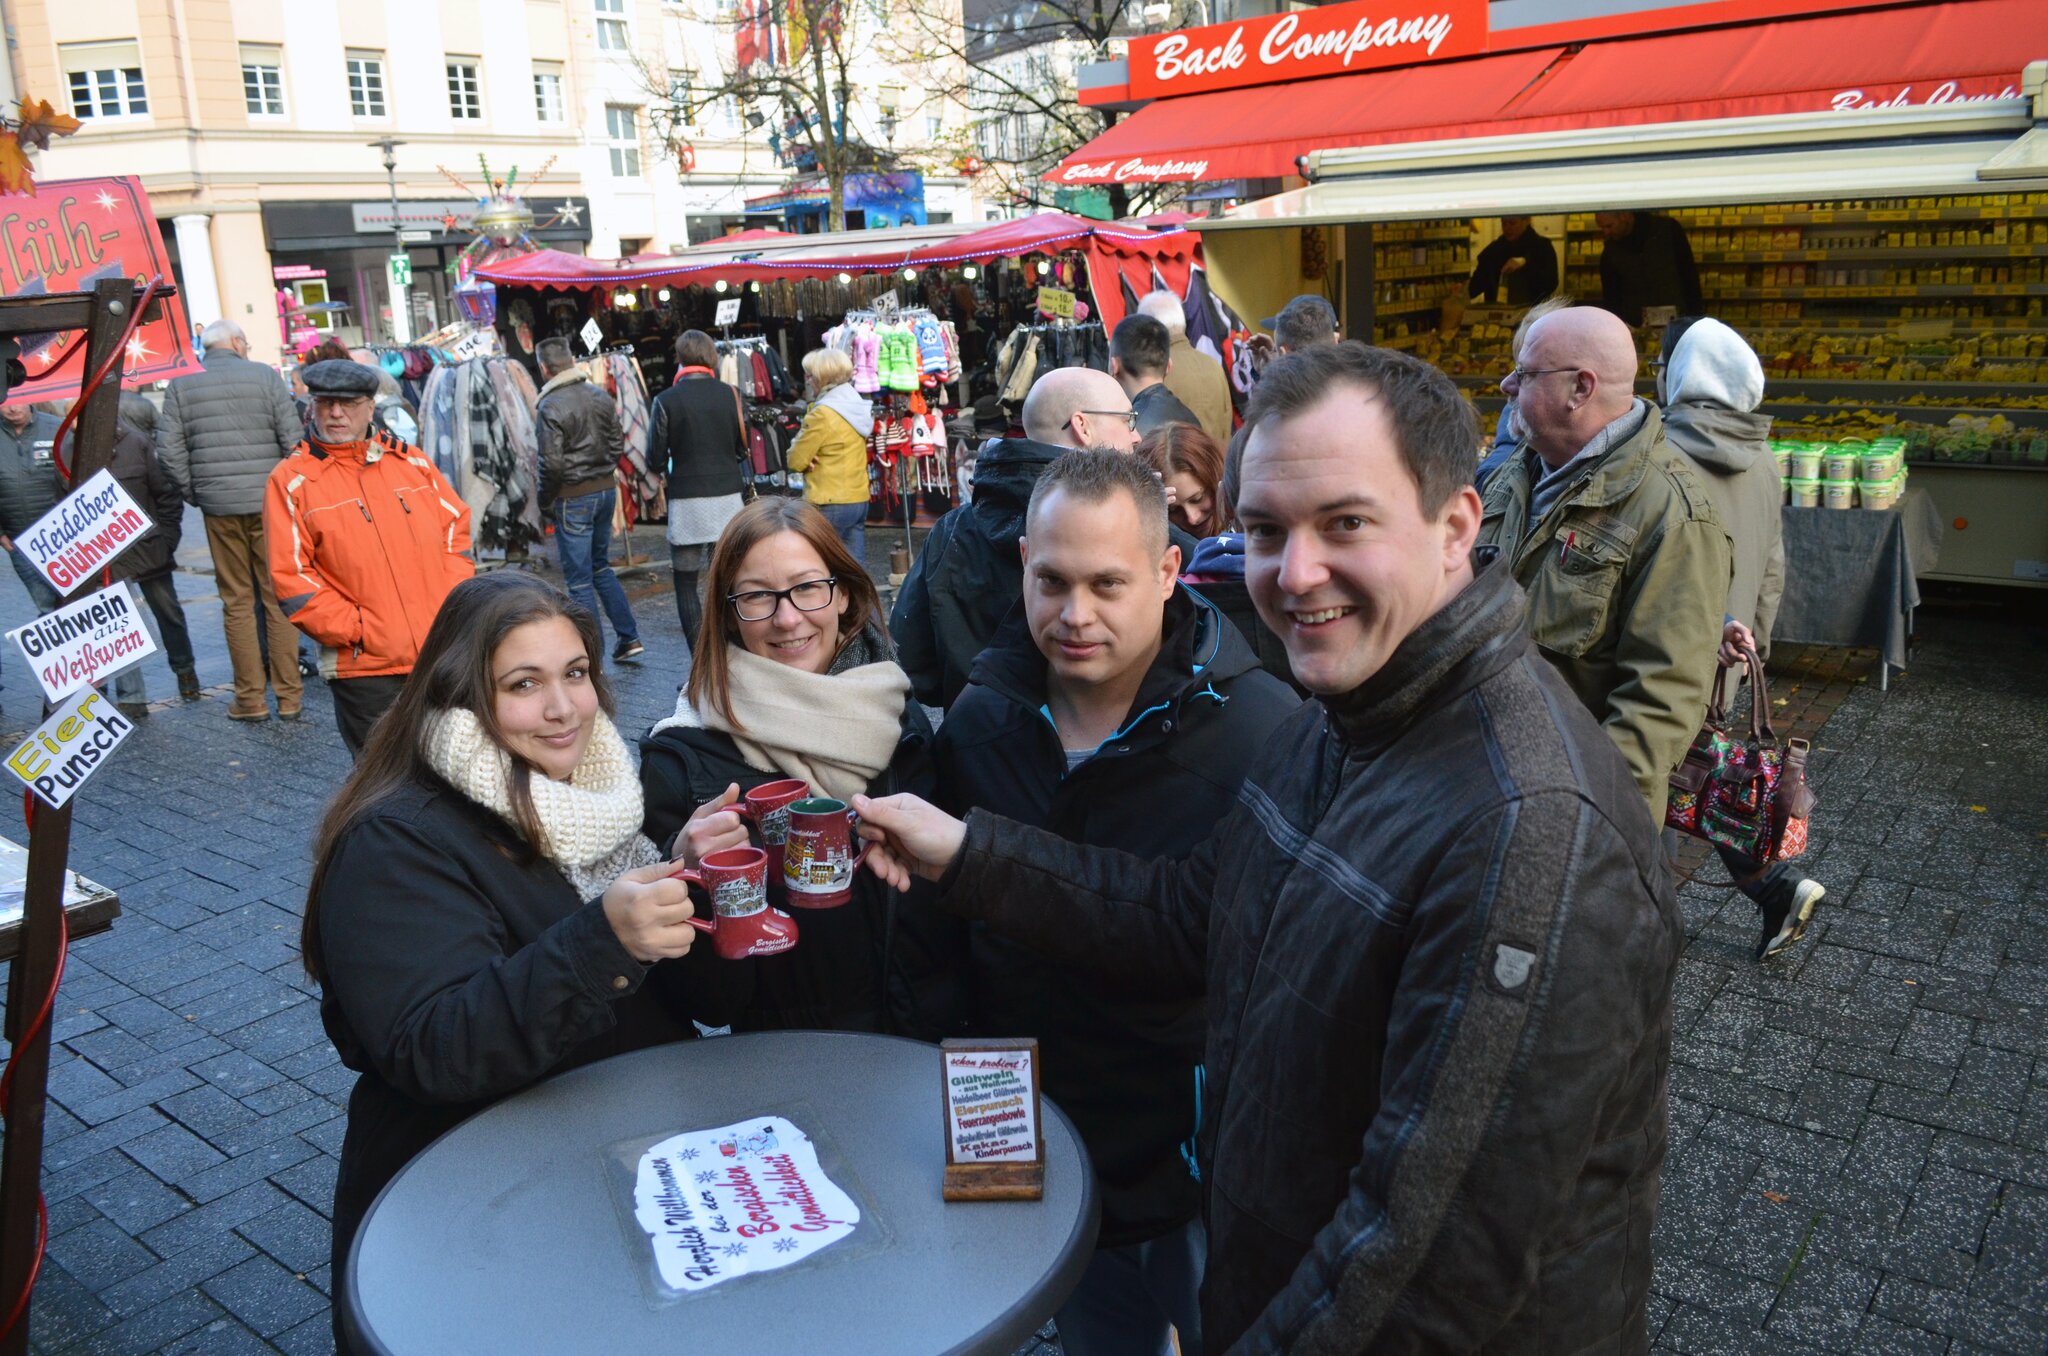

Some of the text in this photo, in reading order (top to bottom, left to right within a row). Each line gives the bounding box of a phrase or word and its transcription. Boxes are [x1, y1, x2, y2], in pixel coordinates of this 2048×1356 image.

[1153, 13, 1453, 80] Back Company
[1062, 157, 1208, 181] Back Company
[458, 336, 482, 355] 14€
[30, 483, 119, 564] Heidelbeer
[47, 508, 144, 588] Glühwein
[20, 593, 129, 657] Glühwein
[94, 615, 130, 641] aus
[43, 626, 145, 690] Weißwein
[9, 693, 100, 782] Eier
[34, 715, 129, 804] Punsch
[950, 1056, 976, 1067] schon
[979, 1058, 1019, 1070] probiert
[951, 1070, 1014, 1086] Glühwein
[952, 1084, 1028, 1105] Heidelbeer Glühwein
[954, 1096, 1024, 1117] Eierpunsch
[964, 1085, 978, 1093] aus
[957, 1107, 1026, 1130] Feuerzangenbowle
[960, 1139, 1009, 1153] Kakao
[975, 1141, 1033, 1160] Kinderpunsch
[714, 1165, 783, 1238] Bergischen
[761, 1153, 845, 1232] Gemütlichkeit
[651, 1157, 722, 1282] Herzlich Willkommen
[700, 1189, 731, 1233] bei der
